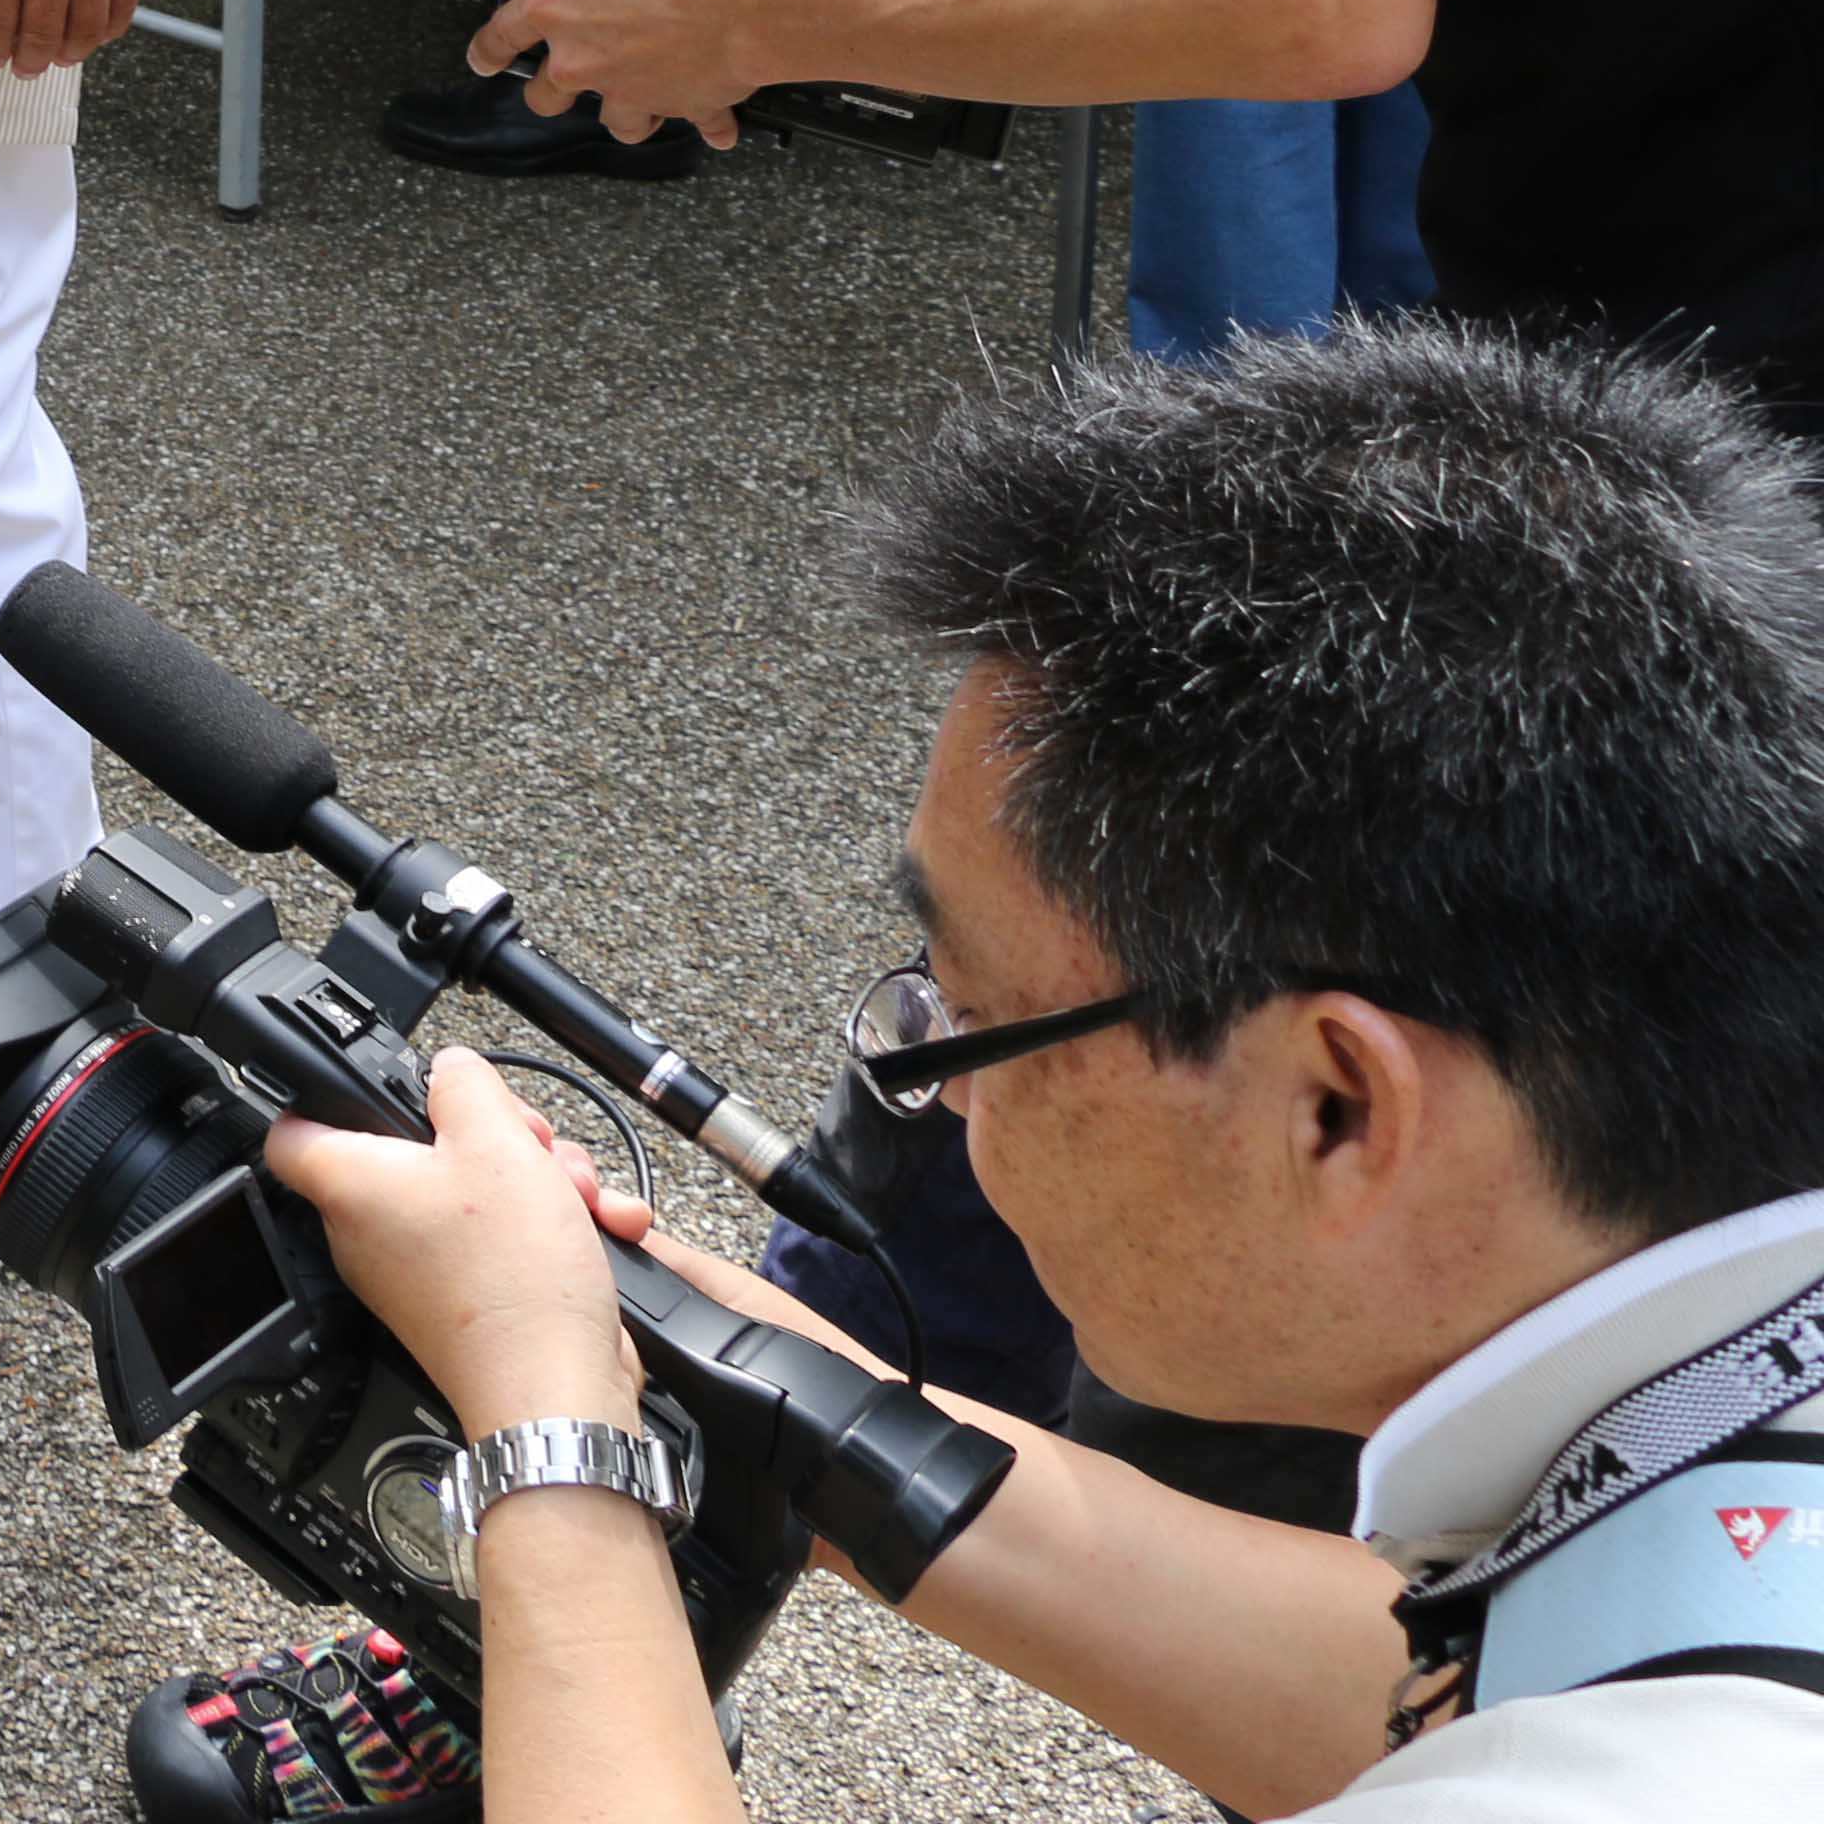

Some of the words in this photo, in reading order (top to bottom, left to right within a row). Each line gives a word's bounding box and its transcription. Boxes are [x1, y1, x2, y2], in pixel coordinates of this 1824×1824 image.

[0, 1141, 19, 1170] VIDEO
[16, 1118, 36, 1144] LENS
[31, 1102, 51, 1121] 20x
[47, 1072, 74, 1103] ZOOM
[390, 1530, 441, 1573] HDV
